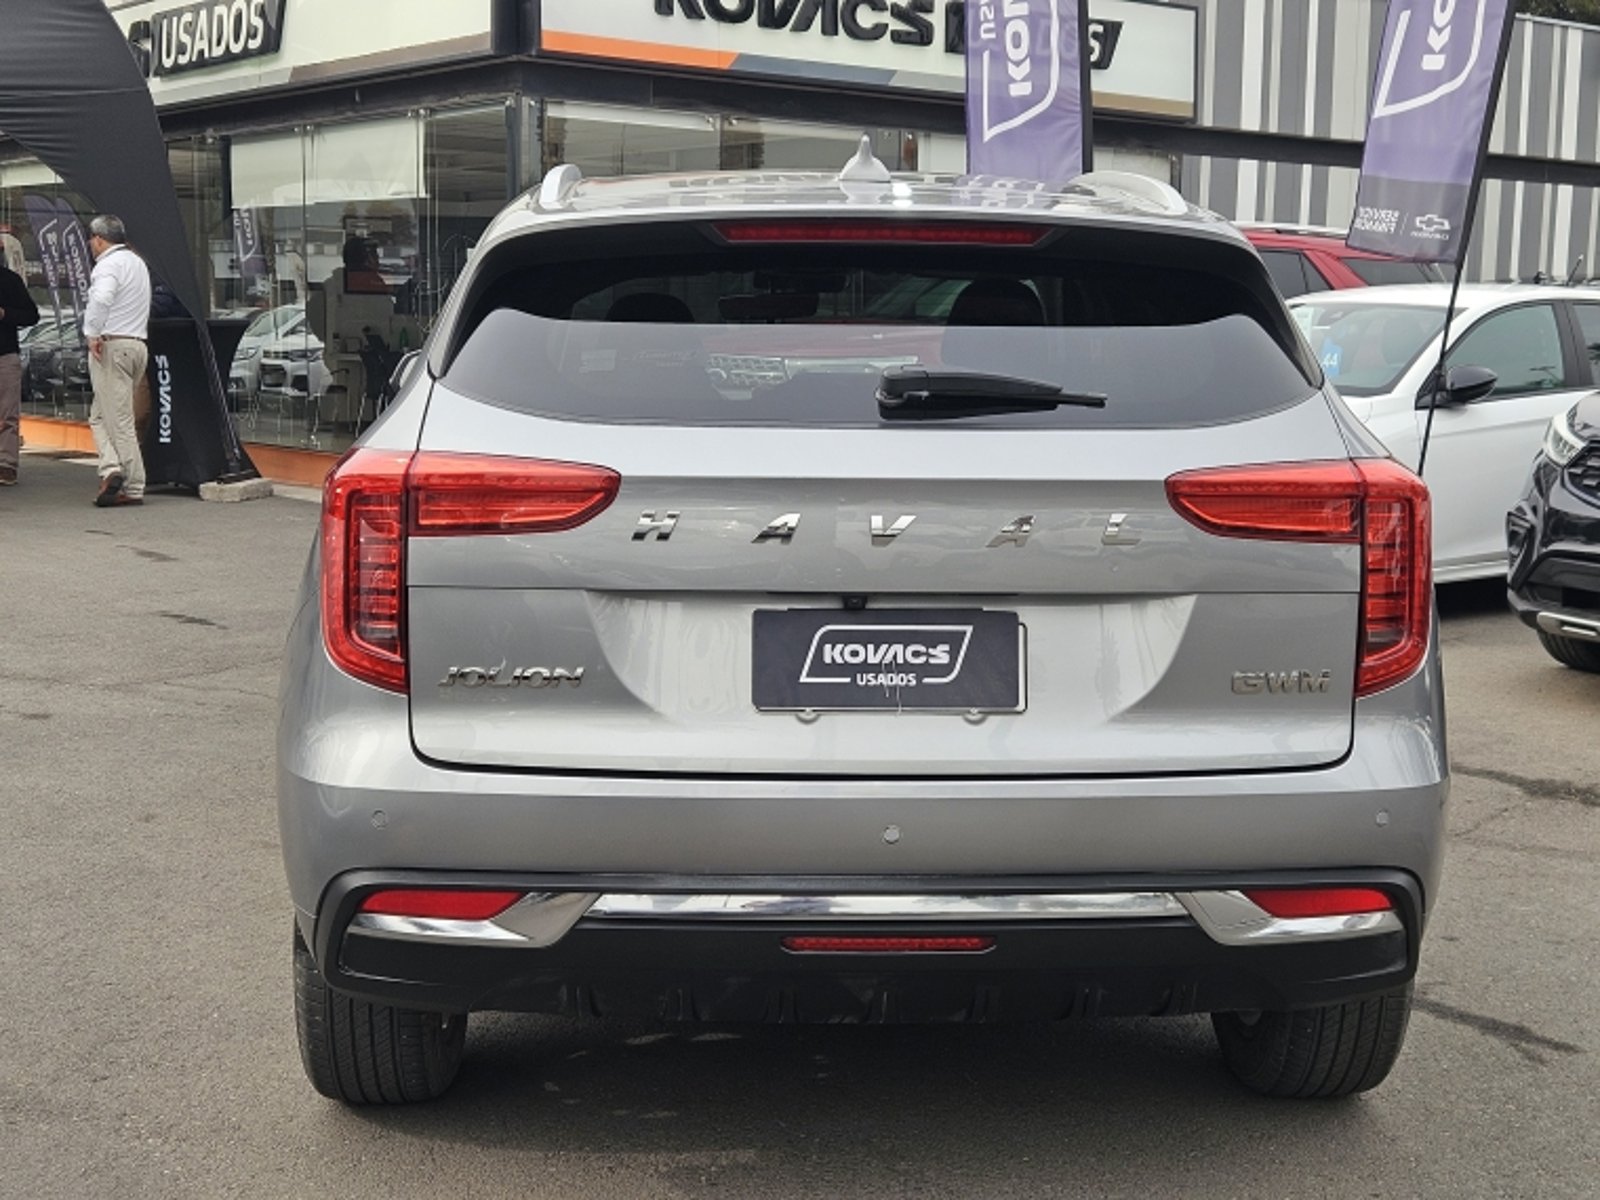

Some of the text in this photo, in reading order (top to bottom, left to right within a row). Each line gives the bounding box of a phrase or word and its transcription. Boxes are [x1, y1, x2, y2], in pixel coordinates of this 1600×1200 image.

[161, 0, 264, 68] USADOS
[155, 355, 171, 443] KOVACS
[631, 510, 1142, 549] HAVAL
[823, 644, 950, 664] KOVACS
[437, 667, 585, 689] JOLION
[856, 673, 917, 686] USADOS
[1231, 669, 1331, 695] GWM
